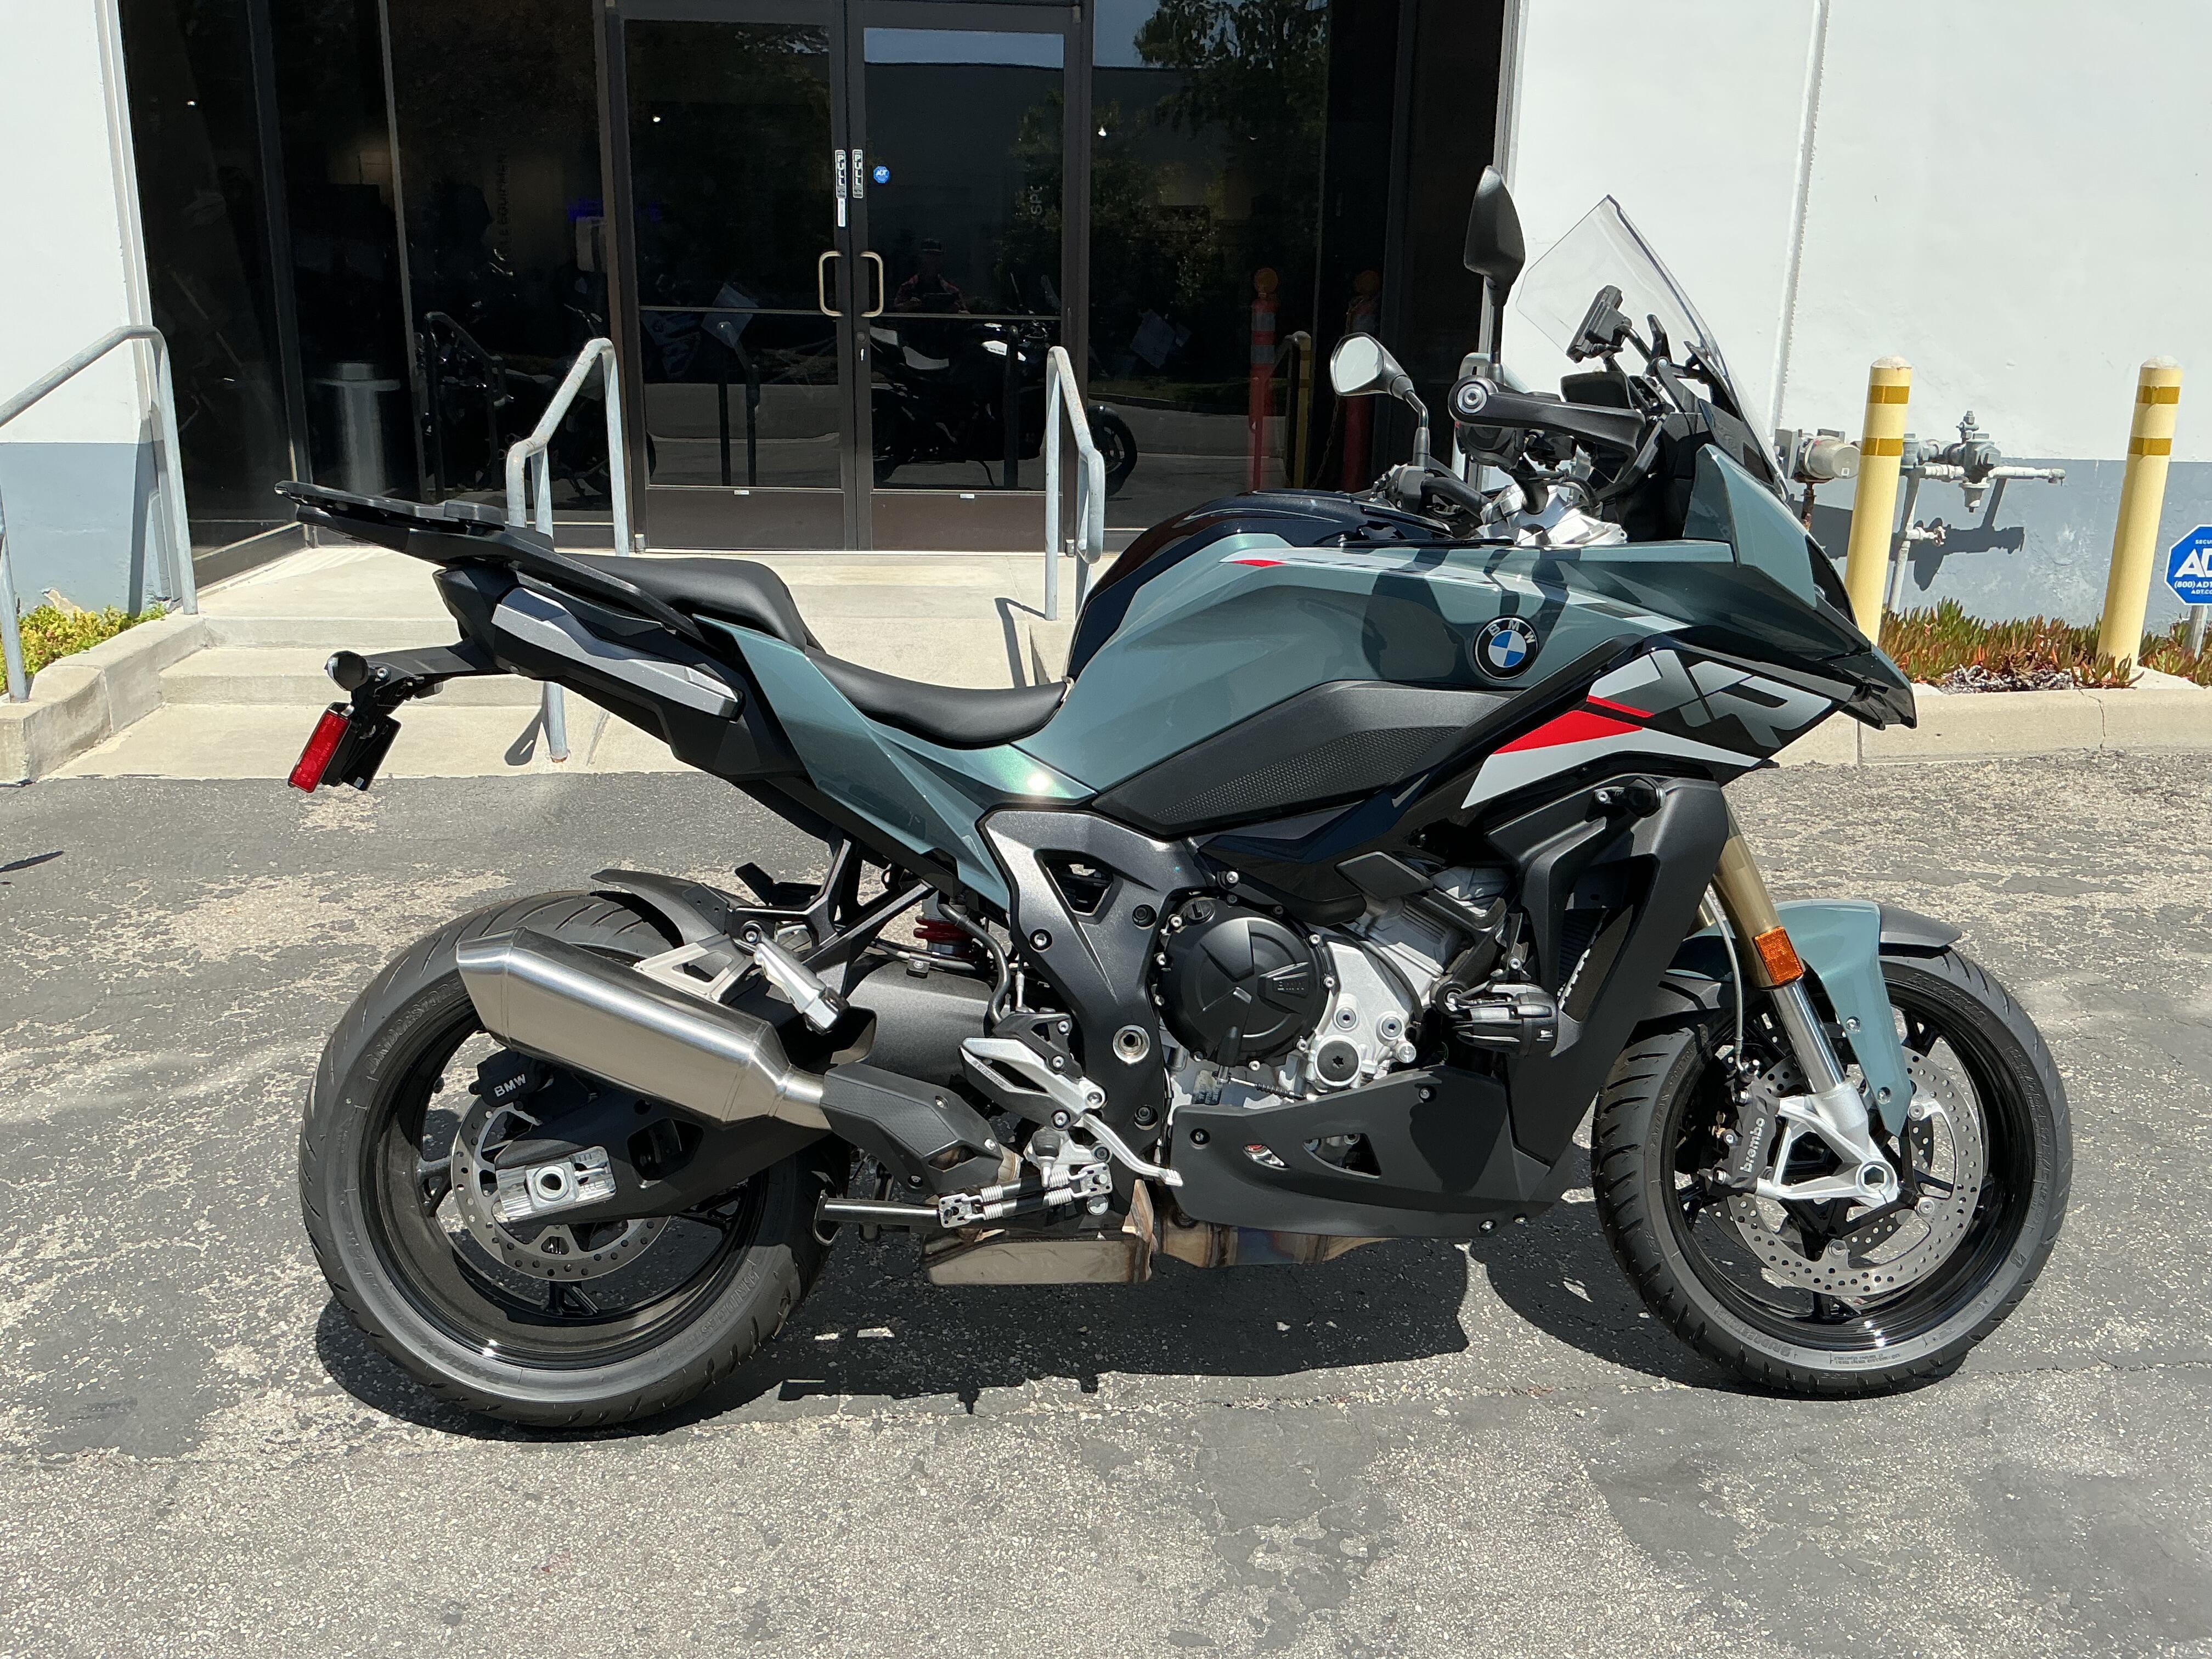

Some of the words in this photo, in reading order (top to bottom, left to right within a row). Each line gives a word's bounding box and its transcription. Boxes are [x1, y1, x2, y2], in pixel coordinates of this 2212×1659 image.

[837, 154, 845, 186] PULL
[854, 154, 862, 185] PULL
[2174, 580, 2196, 589] (800)
[1487, 619, 1536, 644] BMW
[1588, 650, 1832, 750] XR
[494, 1074, 527, 1097] BMW
[1739, 1118, 1765, 1173] brembo
